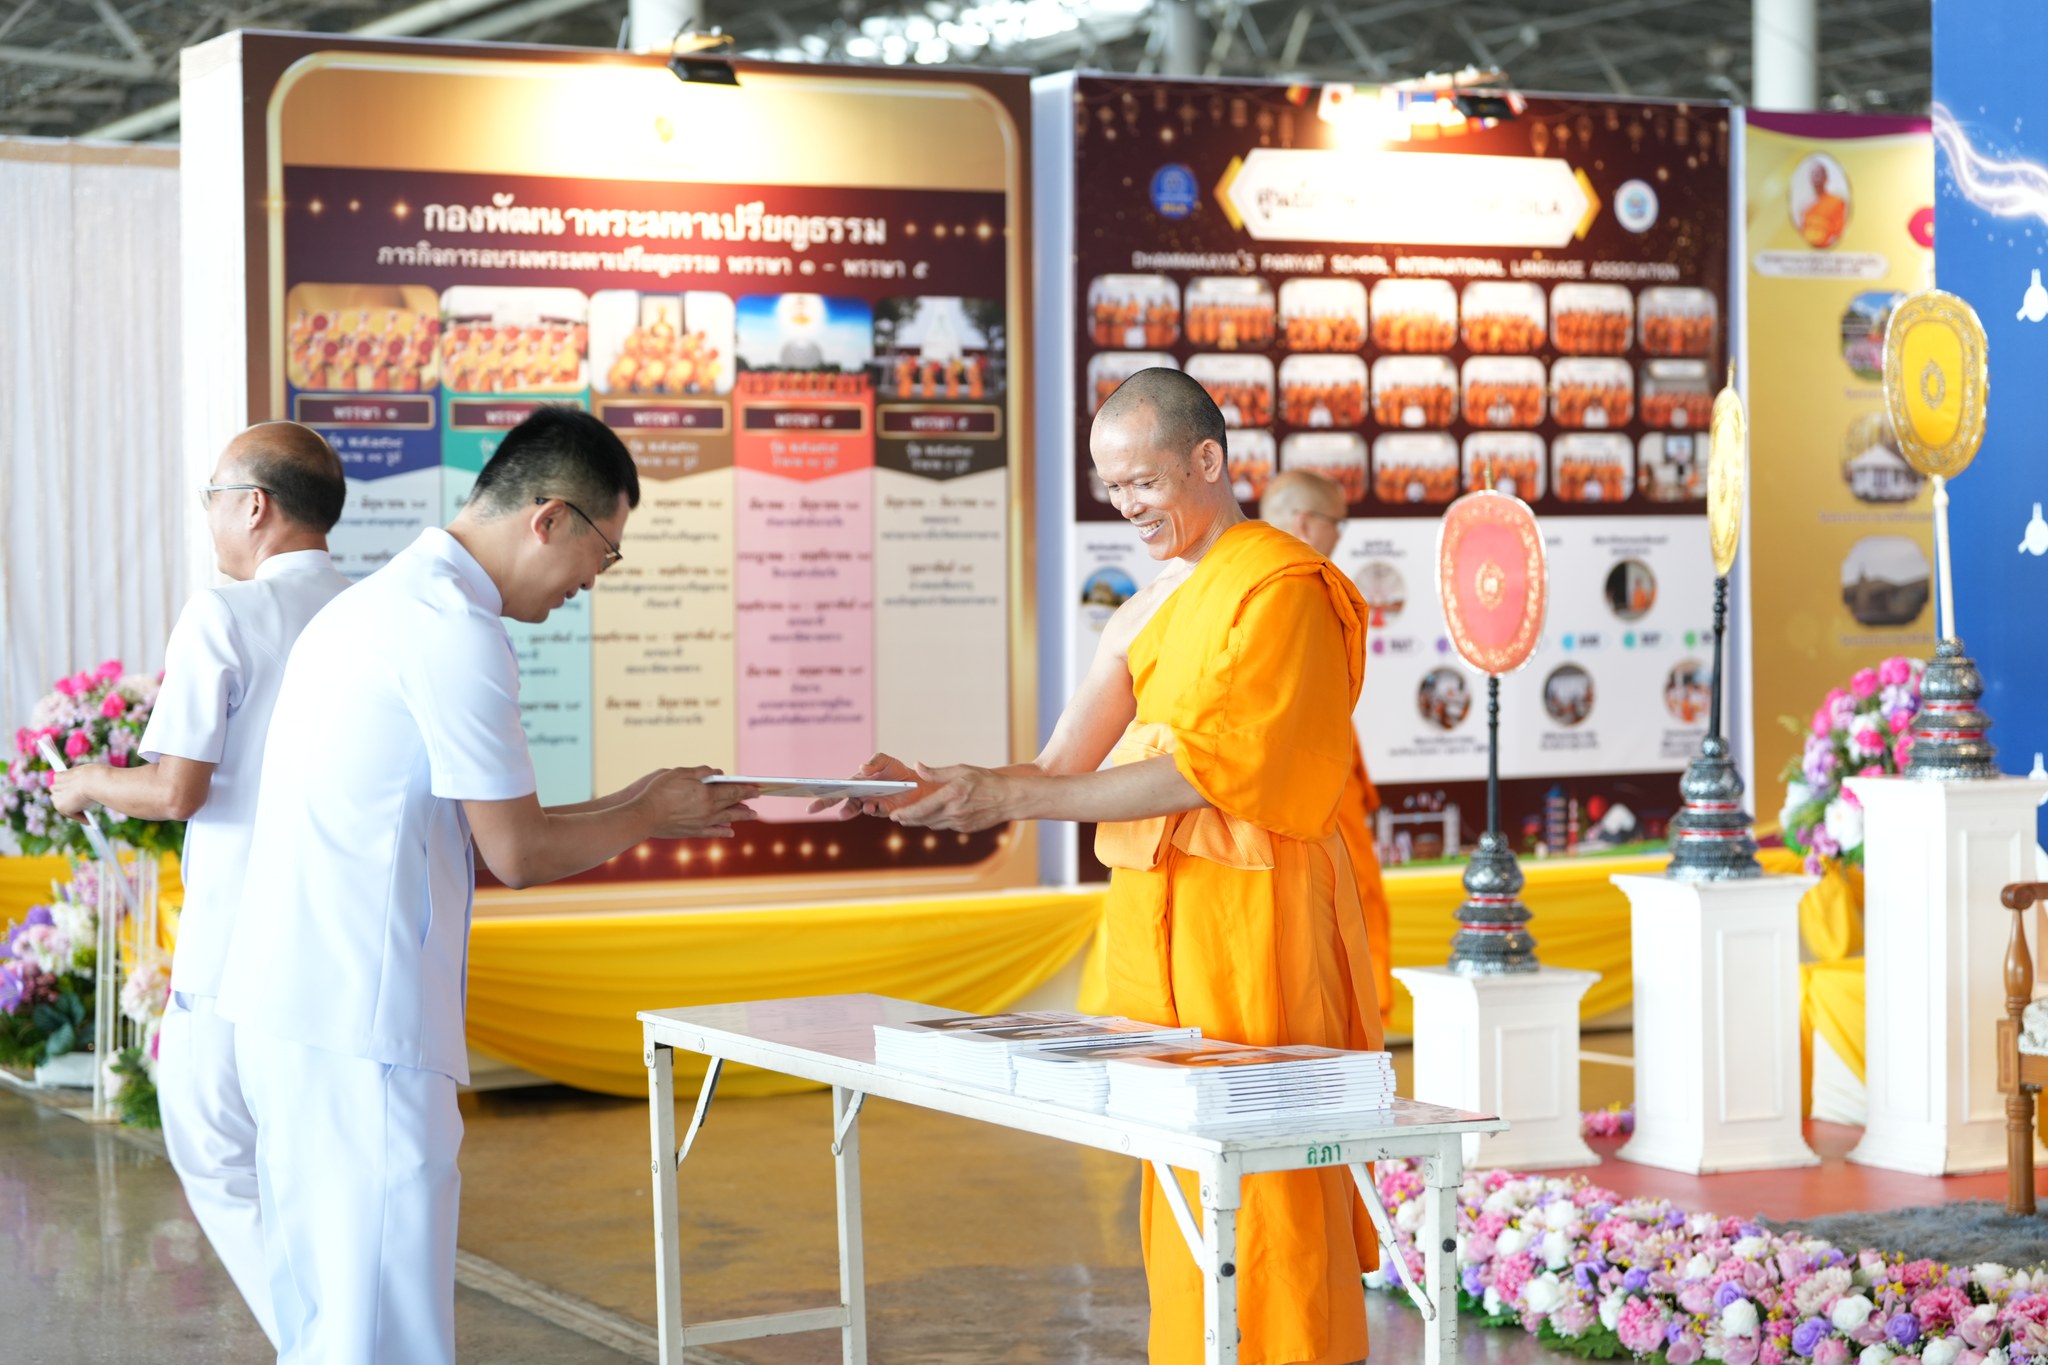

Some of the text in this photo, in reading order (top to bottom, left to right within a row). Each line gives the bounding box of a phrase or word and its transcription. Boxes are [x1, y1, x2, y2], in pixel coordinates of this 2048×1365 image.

[424, 192, 886, 252] กองพัฒนาพระมหาเปรียญธรรม
[727, 256, 792, 276] พรรษา
[842, 258, 906, 279] พรรษา
[1331, 254, 1391, 274] SCHOOL
[1395, 256, 1507, 278] INTERNATIONAL
[1510, 259, 1586, 279] LANGUAGE
[1590, 260, 1680, 281] ASSOCIATION
